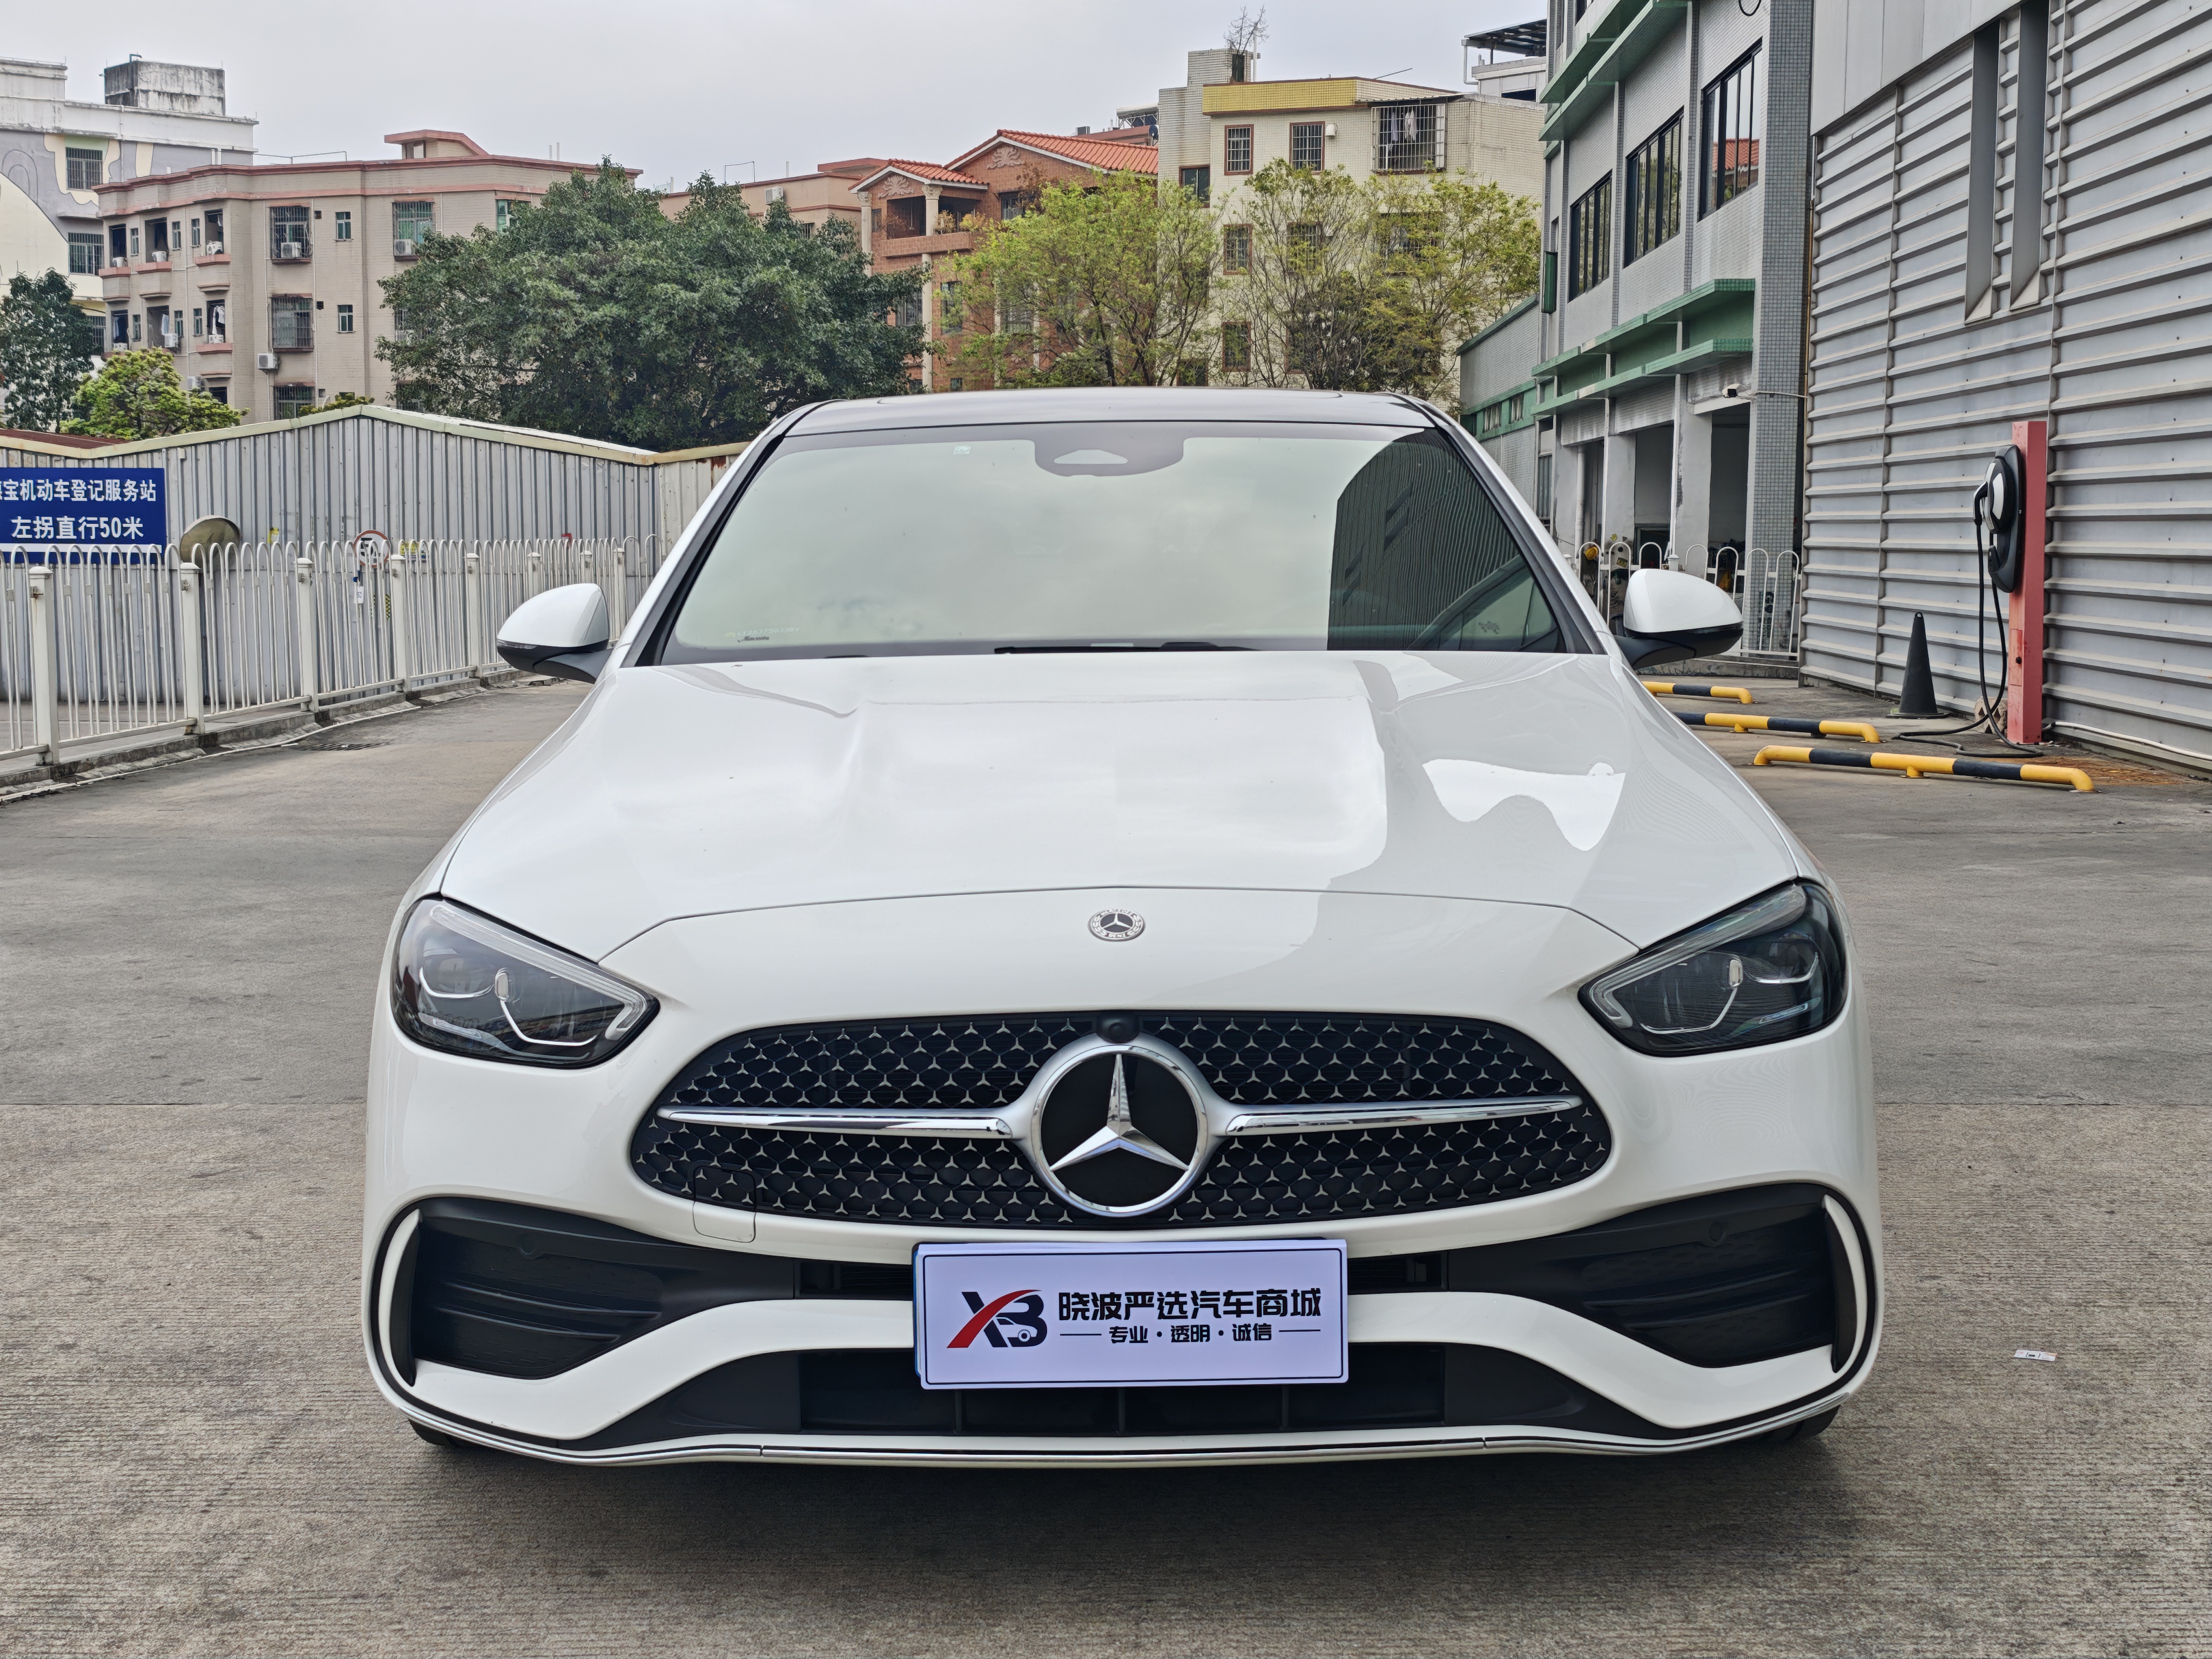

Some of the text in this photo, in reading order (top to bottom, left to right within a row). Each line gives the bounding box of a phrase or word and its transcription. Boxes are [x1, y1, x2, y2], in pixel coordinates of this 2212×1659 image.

[0, 478, 156, 502] 宝机动车登记服务站
[11, 516, 144, 539] 左拐直行50米
[1058, 1287, 1321, 1321] 晓波严选汽车商城
